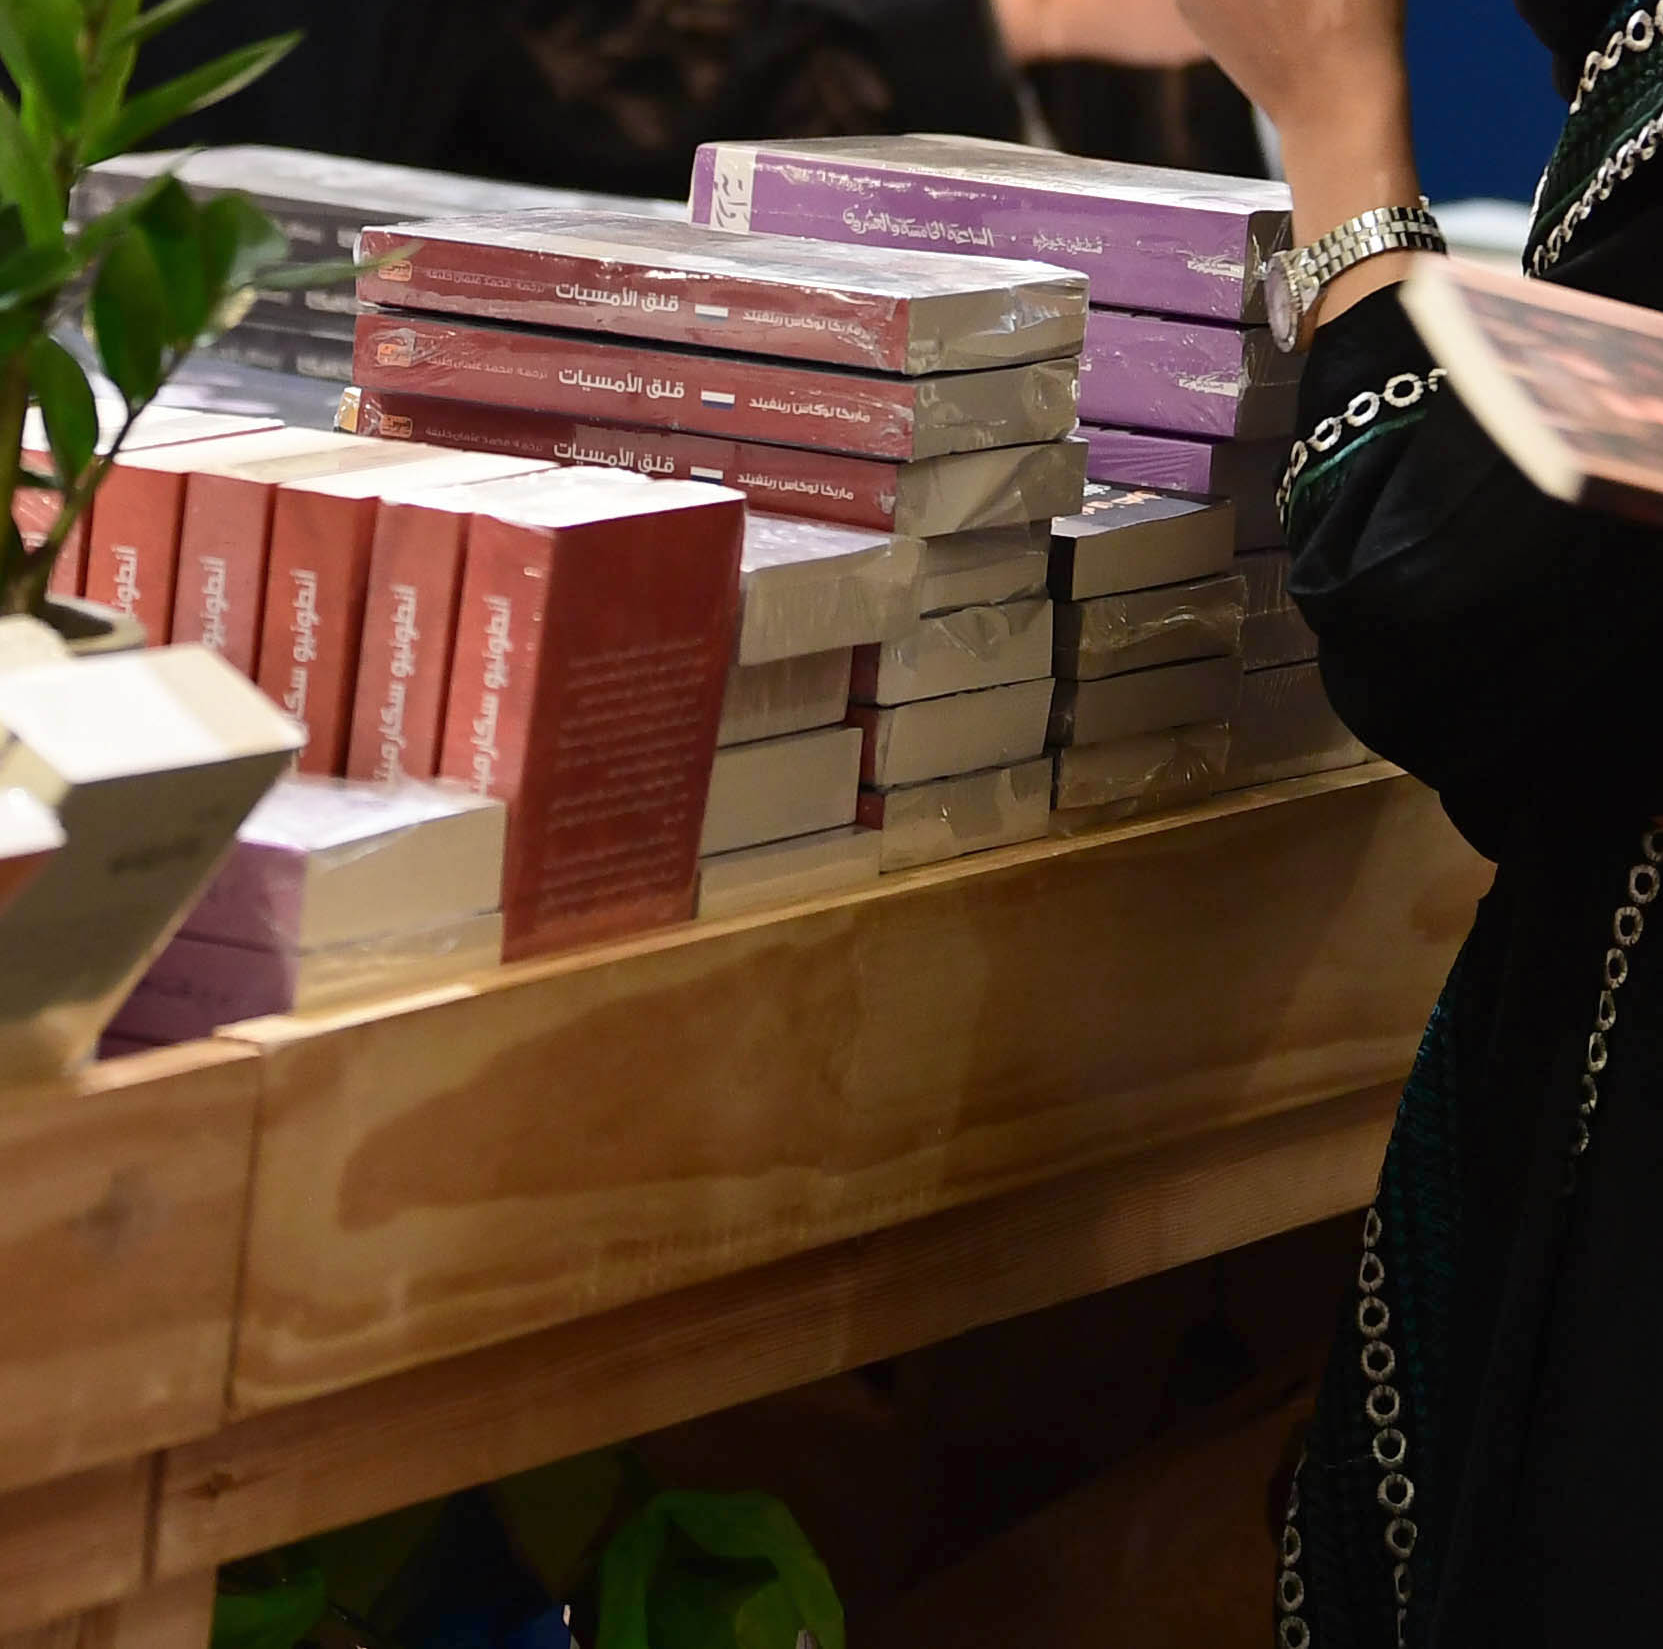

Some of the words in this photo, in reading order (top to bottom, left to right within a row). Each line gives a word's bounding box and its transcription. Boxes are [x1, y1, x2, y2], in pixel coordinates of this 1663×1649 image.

[841, 204, 902, 237] والعشرون
[902, 217, 947, 241] الخامسة
[947, 222, 996, 248] الساعة
[555, 283, 638, 308] الأمسيات
[640, 292, 679, 312] قلق
[558, 368, 643, 393] الأمسيات
[645, 378, 686, 399] قلق
[792, 403, 835, 419] لوكاس
[553, 442, 635, 468] الأمسيات
[636, 452, 675, 473] قلق
[778, 479, 819, 495] لوكاس
[289, 568, 323, 664] أنطونيو
[389, 584, 421, 679] أنطونيو
[482, 593, 515, 690] أنطونيو
